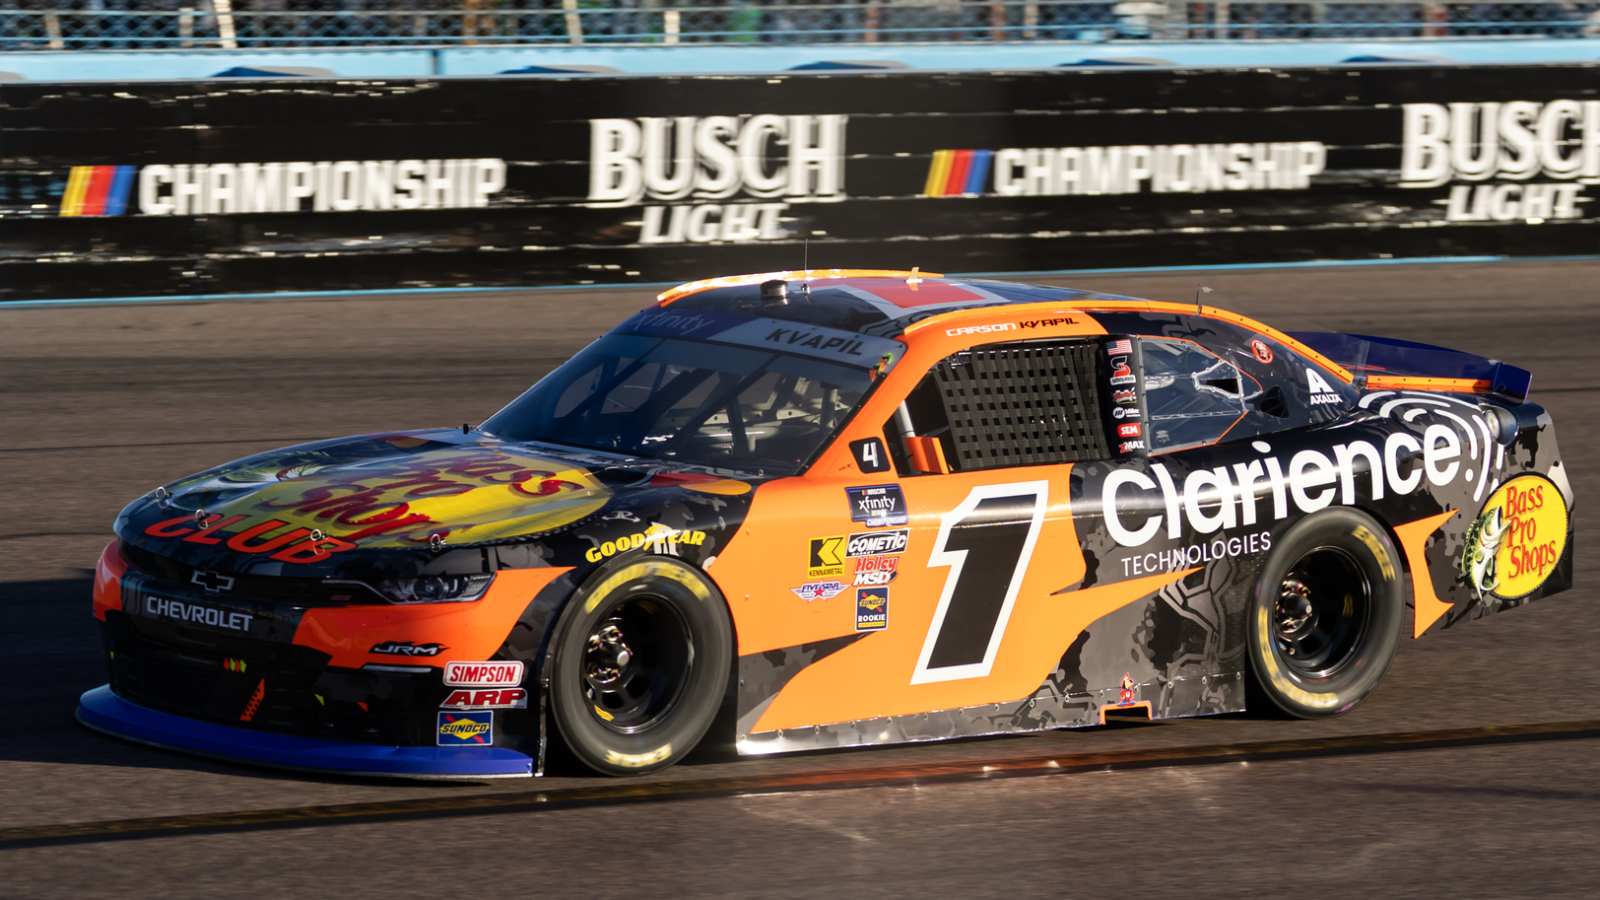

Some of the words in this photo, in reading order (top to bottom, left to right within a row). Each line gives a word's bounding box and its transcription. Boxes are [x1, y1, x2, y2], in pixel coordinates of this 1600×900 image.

[586, 114, 849, 208] BUSCH
[995, 141, 1324, 196] CHAMPIONSHIP
[139, 158, 505, 216] CHAMPIONSHIP
[1446, 184, 1585, 221] LIGHT
[638, 203, 790, 243] LIGHT
[631, 313, 715, 336] xfinity
[945, 322, 1016, 336] CARSON
[1019, 318, 1080, 329] KVAPIL
[764, 328, 866, 356] KVAPIL
[1310, 393, 1343, 405] AXALTA
[1121, 425, 1138, 435] SEM
[863, 441, 879, 467] 4
[1101, 424, 1461, 547] Clarience
[858, 495, 896, 513] xfinity
[1505, 485, 1543, 519] Bass
[145, 513, 358, 564] CLUB
[848, 531, 908, 553] COMETIC
[1506, 517, 1536, 548] Pro
[585, 529, 706, 563] GOODYEAR
[1121, 531, 1273, 577] TECHNOLOGIES
[855, 555, 898, 574] Holley
[1508, 540, 1556, 578] Shops
[809, 568, 844, 577] KENNAMETAL
[853, 571, 891, 586] MSD
[909, 480, 1048, 685] 1
[801, 584, 819, 592] FIVE
[821, 582, 840, 591] STAR
[146, 595, 253, 631] CHEVROLET
[860, 598, 885, 606] SUNOCO
[858, 614, 886, 622] ROOKIE
[373, 644, 438, 656] JRM
[450, 666, 516, 682] SIMPSON
[444, 689, 526, 705] ARP
[442, 724, 488, 733] SUNOCO
